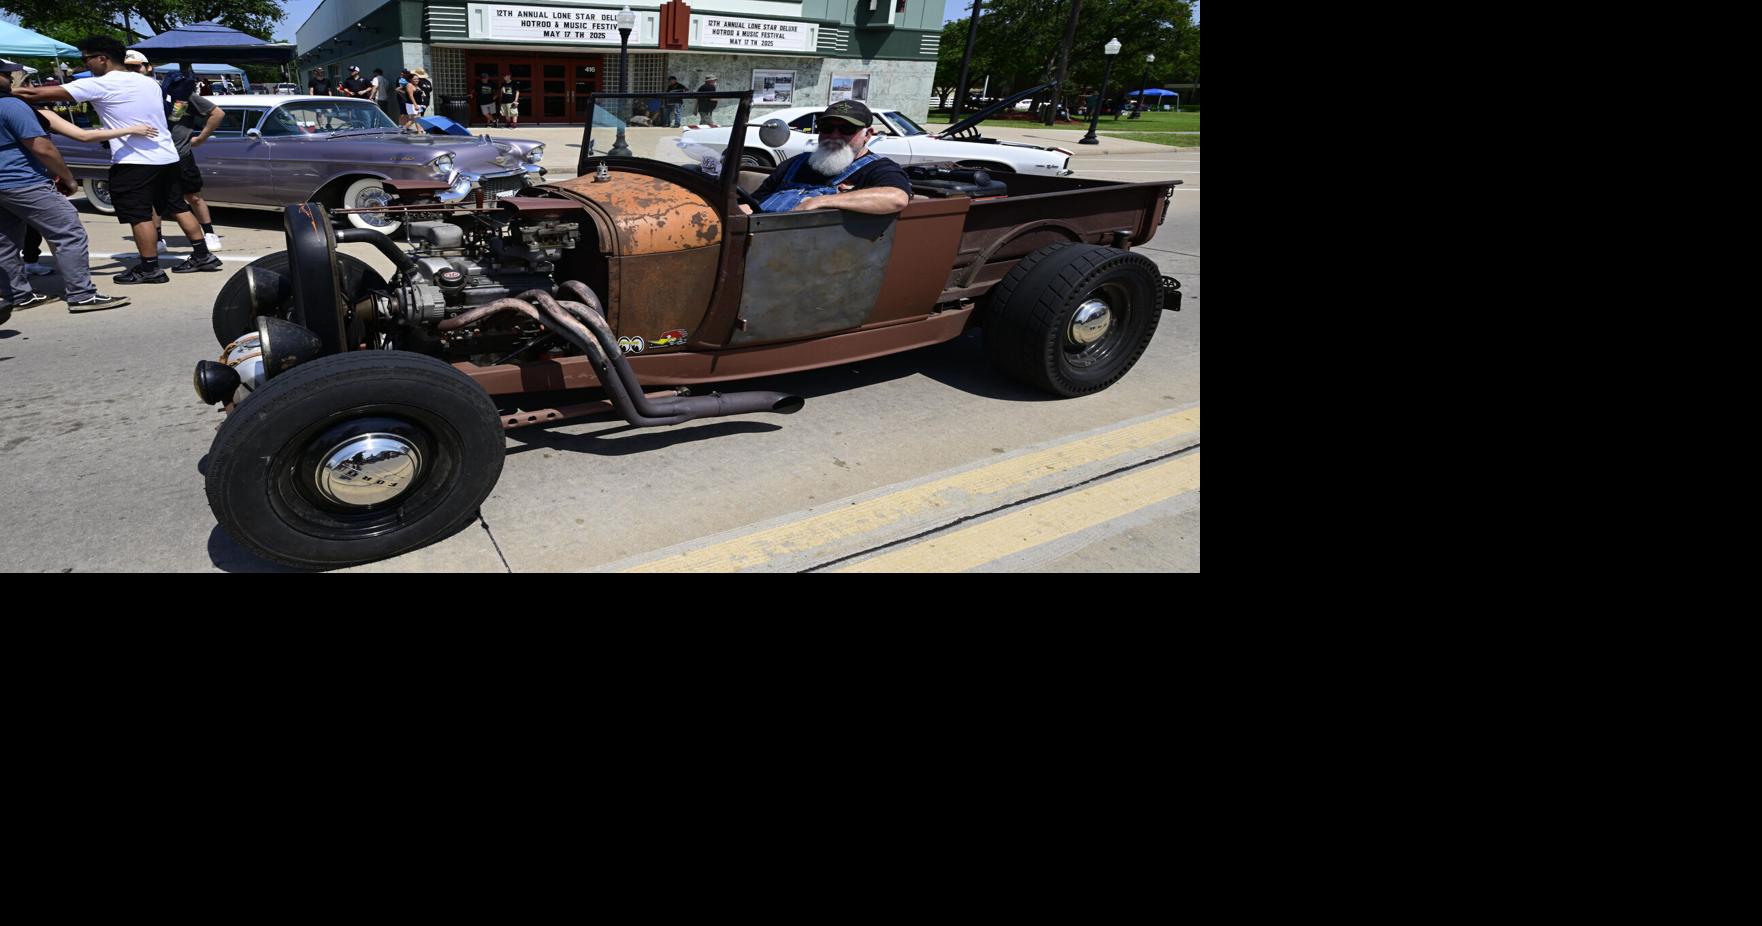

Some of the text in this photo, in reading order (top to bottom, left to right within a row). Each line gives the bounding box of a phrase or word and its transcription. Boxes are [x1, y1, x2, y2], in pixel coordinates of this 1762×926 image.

[517, 11, 549, 19] ANNUAL
[552, 12, 572, 20] LONE
[521, 20, 551, 28] HOTROD
[723, 21, 745, 29] ANNUAL
[543, 30, 561, 38] MAY
[347, 470, 398, 487] FORD
